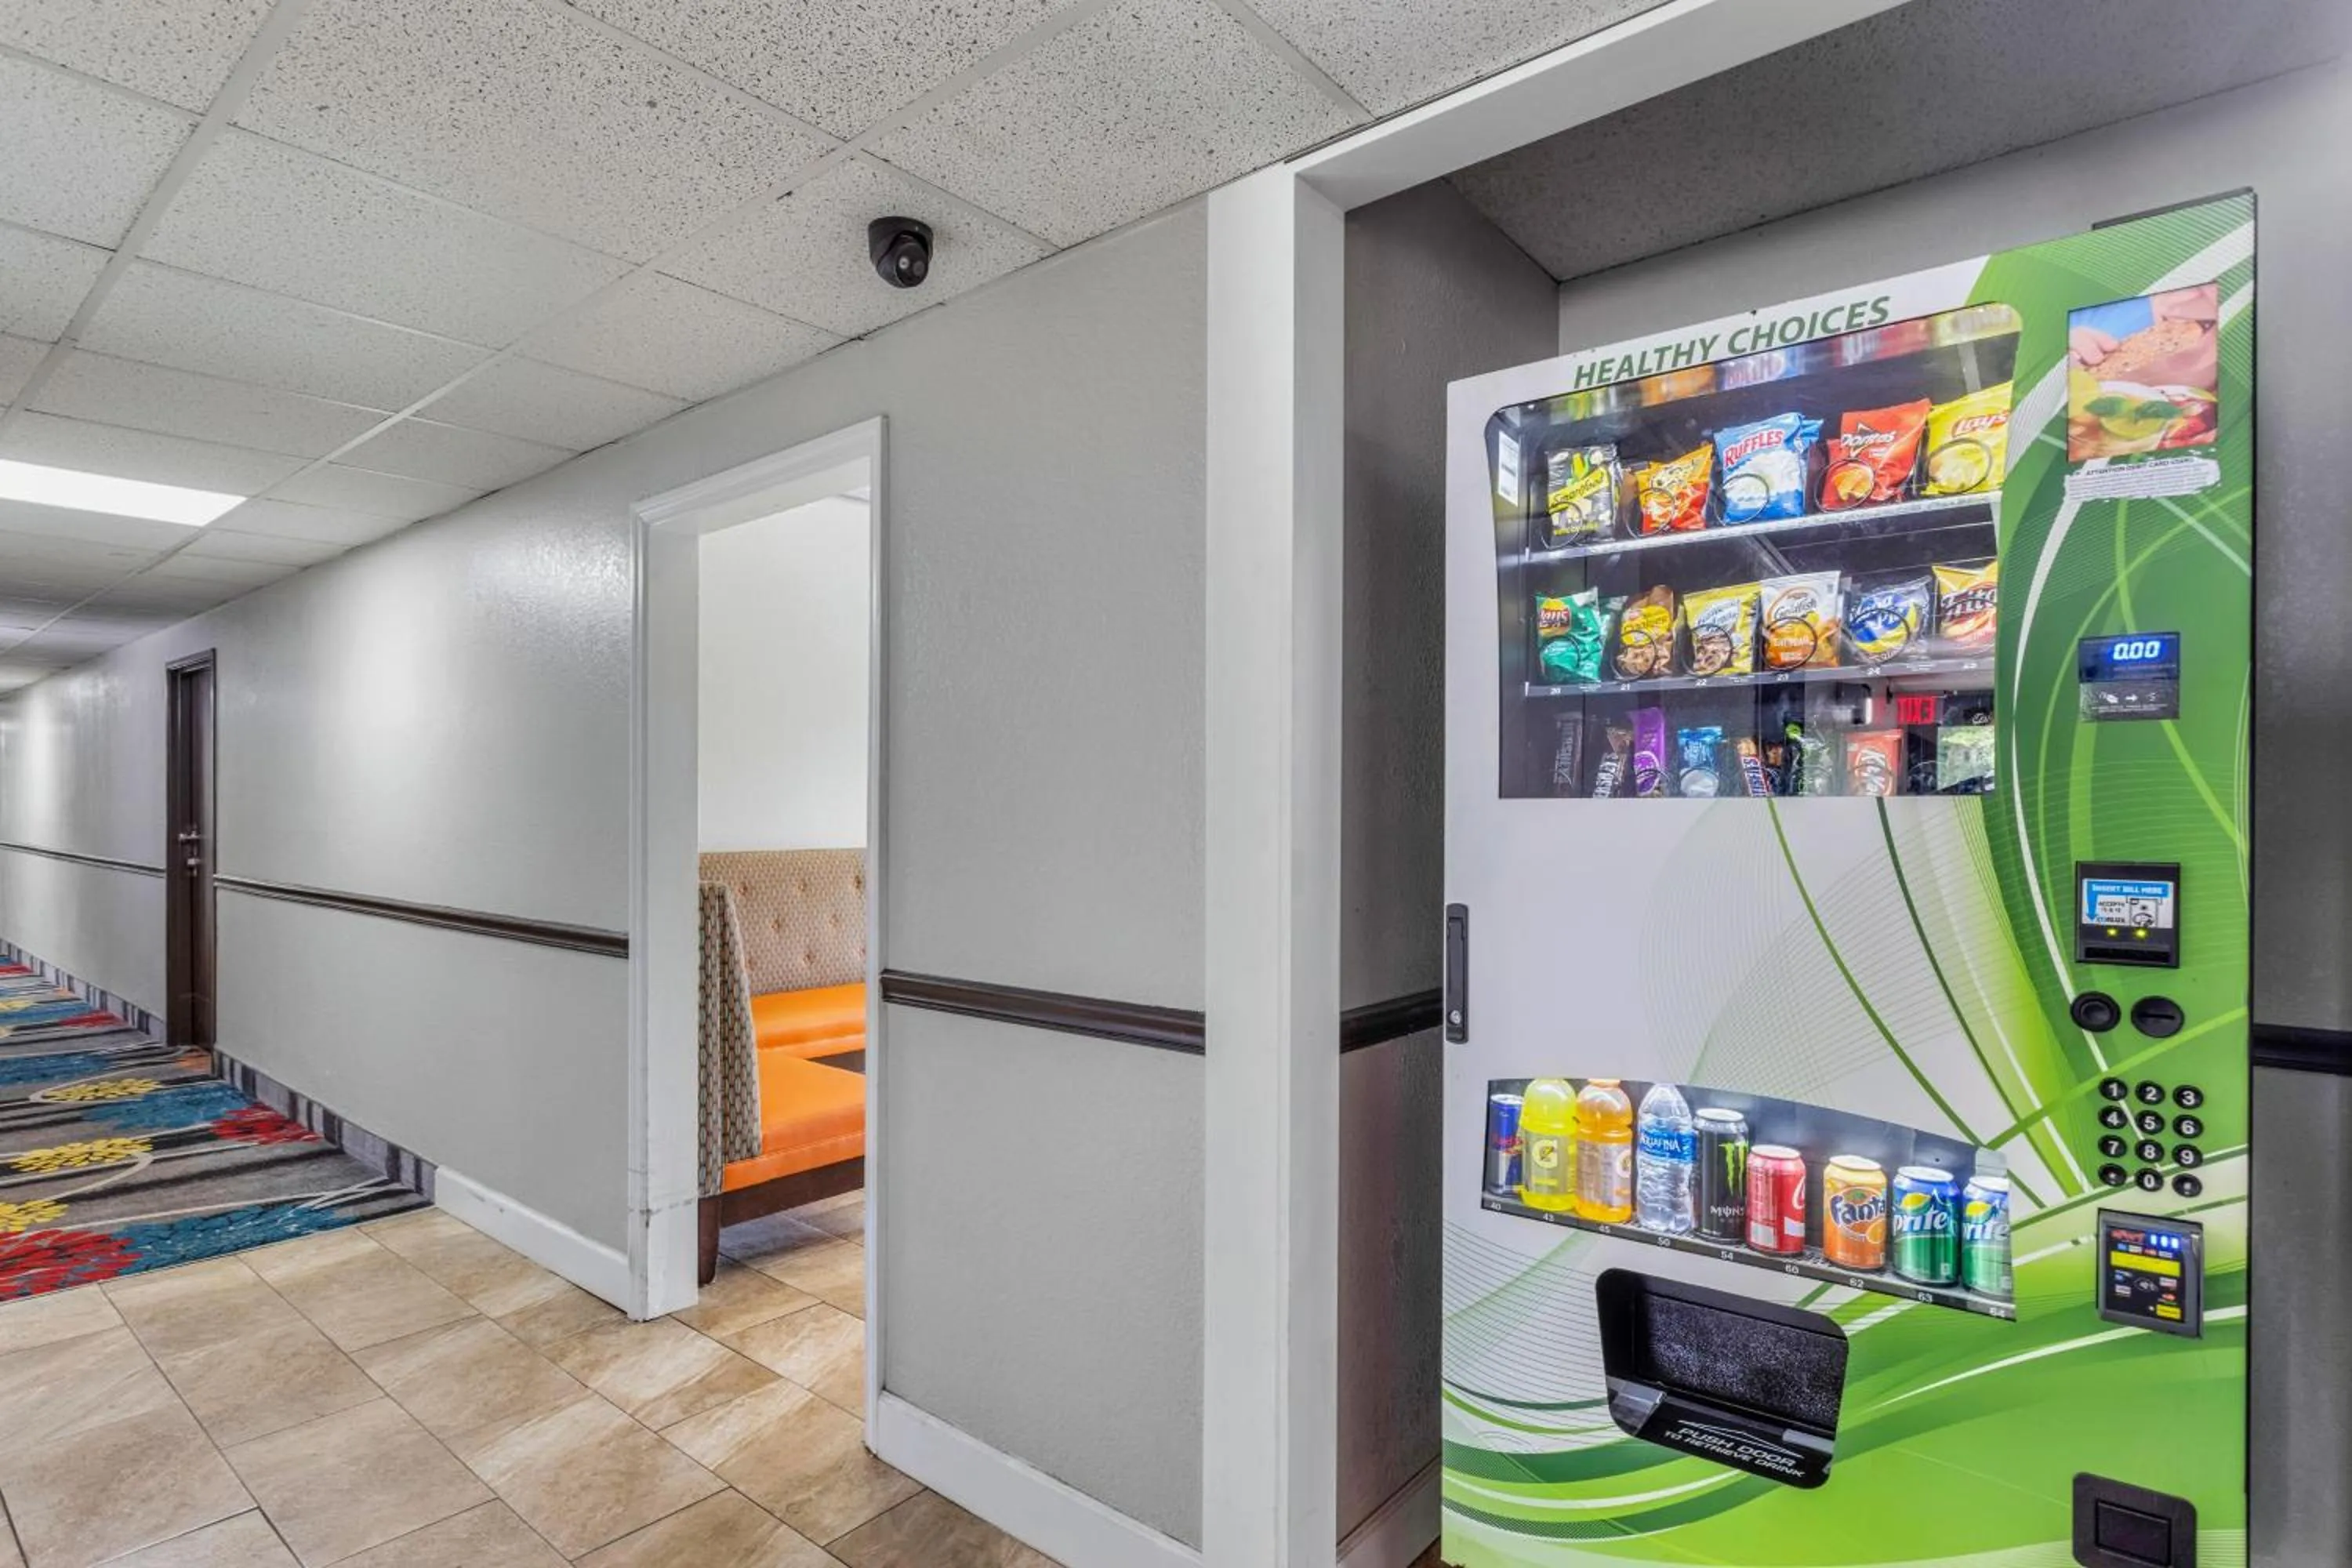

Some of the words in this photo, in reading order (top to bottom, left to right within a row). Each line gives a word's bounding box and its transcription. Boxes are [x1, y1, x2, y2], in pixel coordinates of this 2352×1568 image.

[1573, 334, 1720, 390] HEALTHY
[1728, 296, 1891, 354] CHOICES
[1841, 430, 1896, 446] Doritos
[1725, 430, 1784, 468] RUFFLES
[2113, 640, 2161, 660] 0.00
[2109, 1083, 2118, 1097] 1
[2146, 1087, 2157, 1101] 2
[2182, 1091, 2195, 1105] 3
[2107, 1112, 2118, 1126] 4
[2144, 1116, 2155, 1130] 5
[2182, 1120, 2195, 1135] 6
[2107, 1141, 2118, 1155] 7
[2144, 1145, 2155, 1159] 8
[2181, 1149, 2194, 1164] 9
[2143, 1174, 2154, 1188] 0
[1893, 1204, 1948, 1236] prite
[1657, 1236, 1671, 1247] 50
[1721, 1250, 1733, 1261] 54
[1784, 1264, 1799, 1274] 60
[1663, 1430, 1682, 1441] TO
[1685, 1436, 1755, 1462] RETRIEVE
[1754, 1459, 1806, 1478] DRINK
[1678, 1427, 1735, 1449] PUSH
[1737, 1445, 1797, 1467] DOOR
